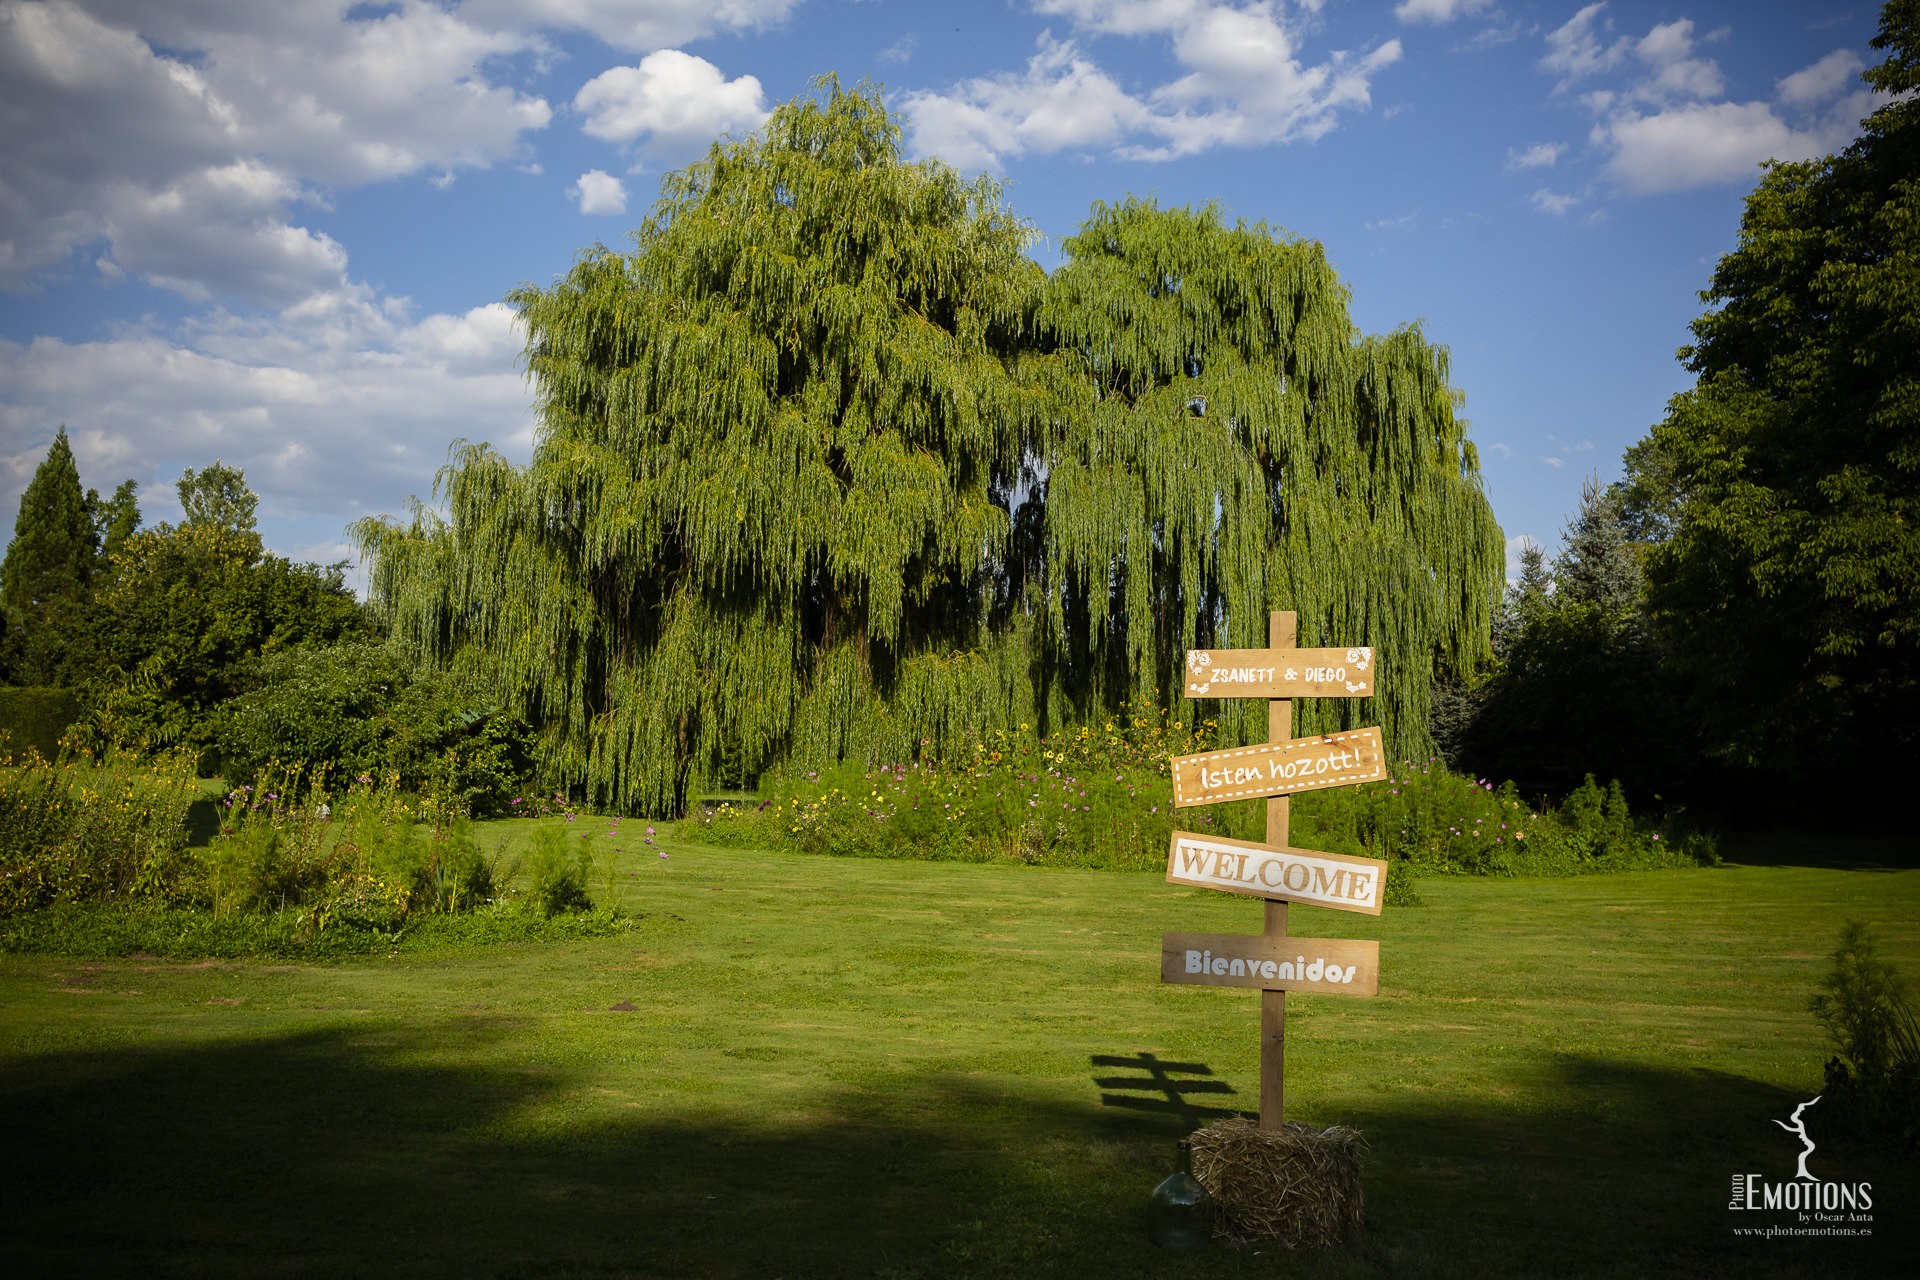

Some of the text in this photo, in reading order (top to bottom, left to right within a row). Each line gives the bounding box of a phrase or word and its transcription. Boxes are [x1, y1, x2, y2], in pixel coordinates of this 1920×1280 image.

[1210, 667, 1346, 683] ZSANETT & DIEGO
[1201, 748, 1361, 789] Isten hozott!
[1180, 845, 1371, 901] WELCOME
[1185, 950, 1356, 984] Bienvenidos
